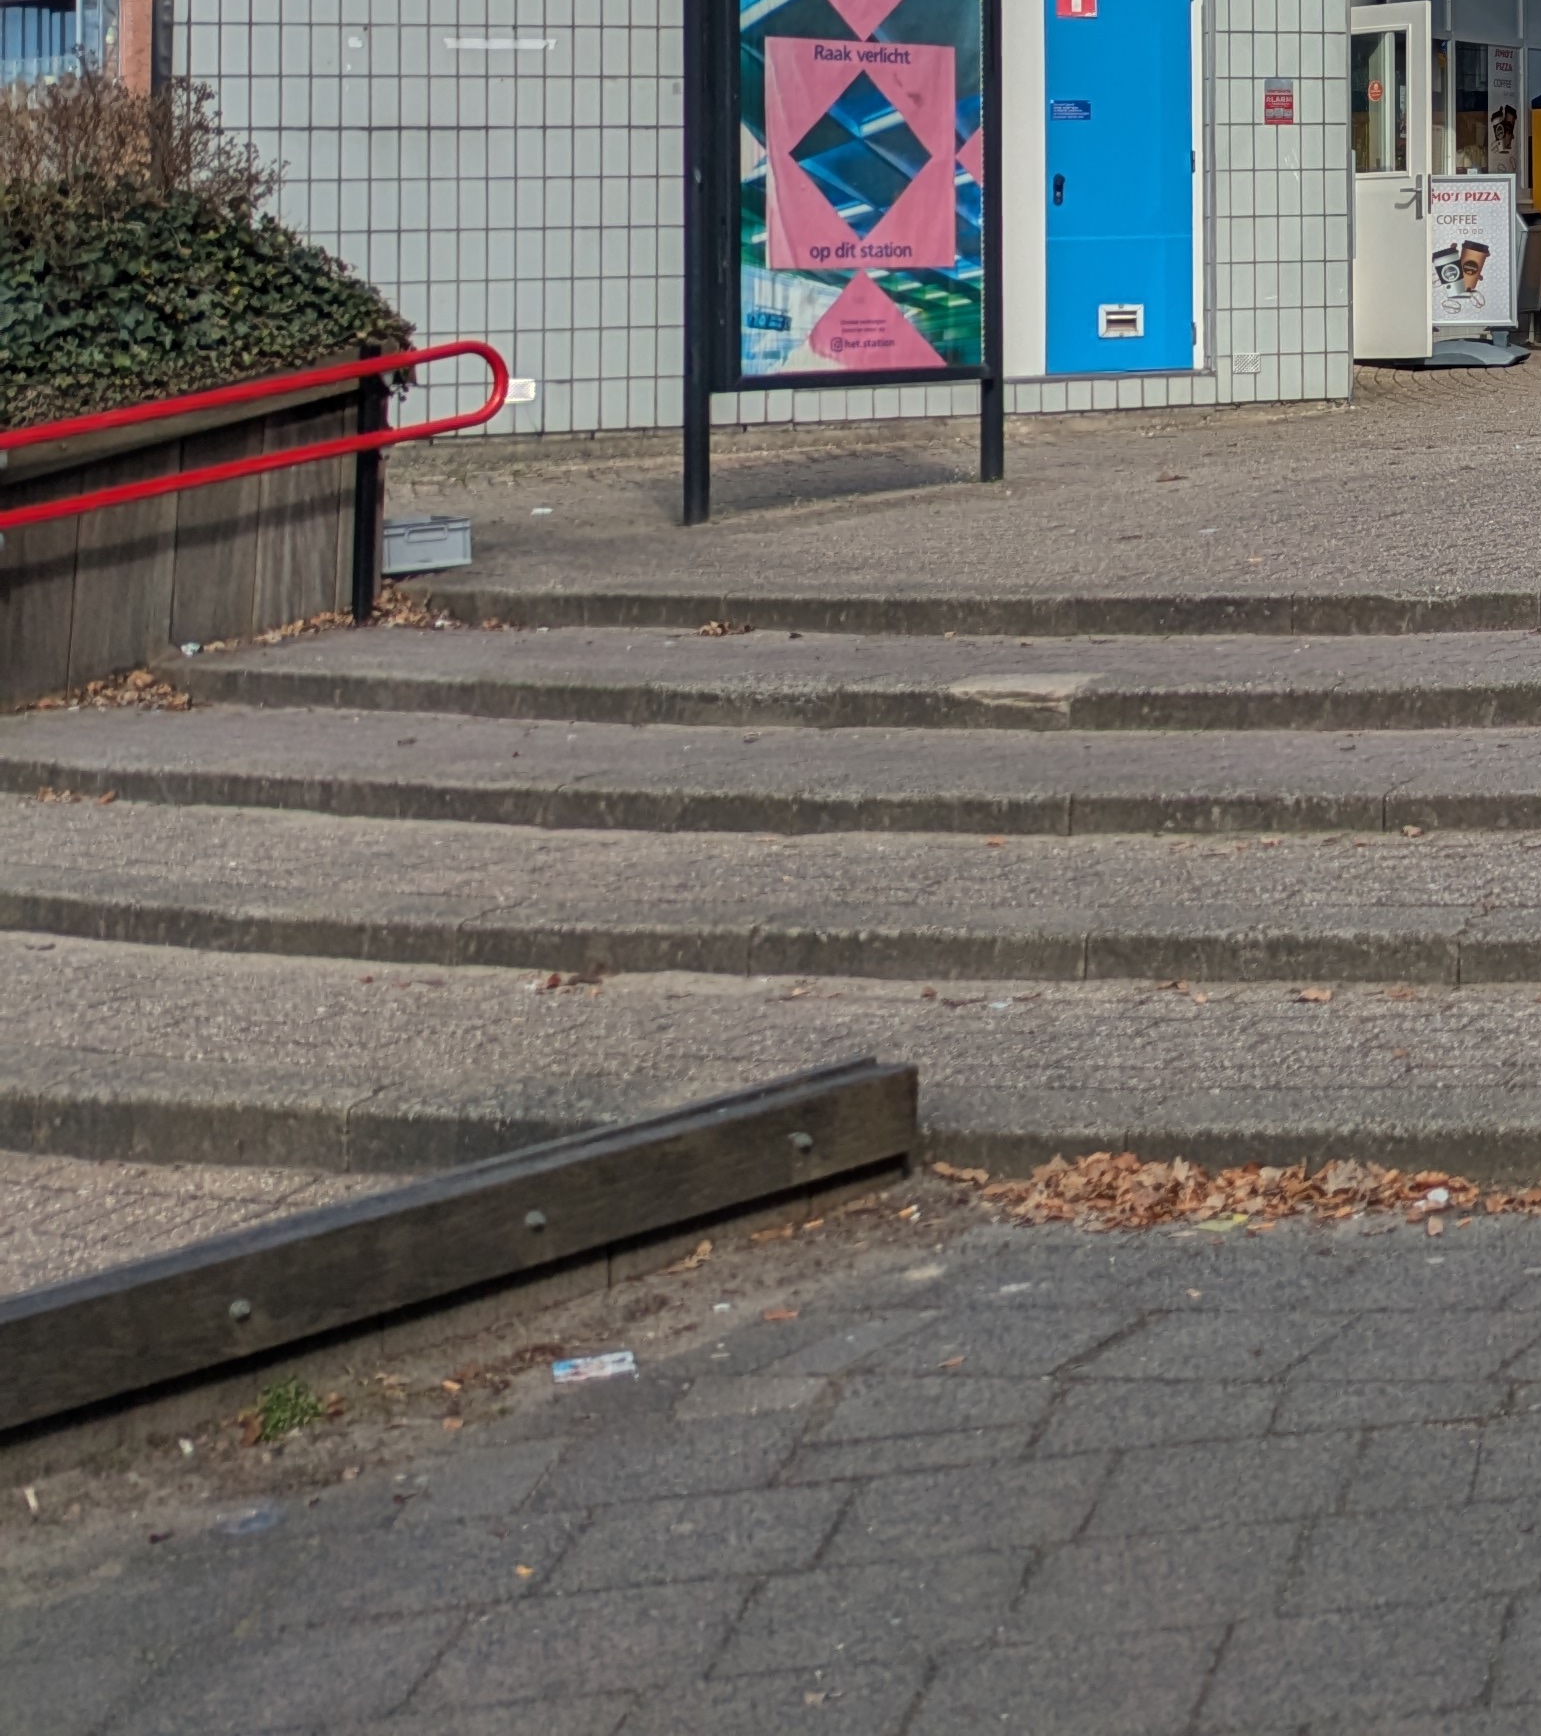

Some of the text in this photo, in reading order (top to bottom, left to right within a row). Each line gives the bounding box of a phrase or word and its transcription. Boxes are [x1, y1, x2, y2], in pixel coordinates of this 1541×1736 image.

[814, 44, 911, 64] Raak verlicht
[1431, 191, 1502, 202] MO'S PIZZA
[1436, 214, 1478, 225] COFFEE
[809, 241, 912, 263] op dit station
